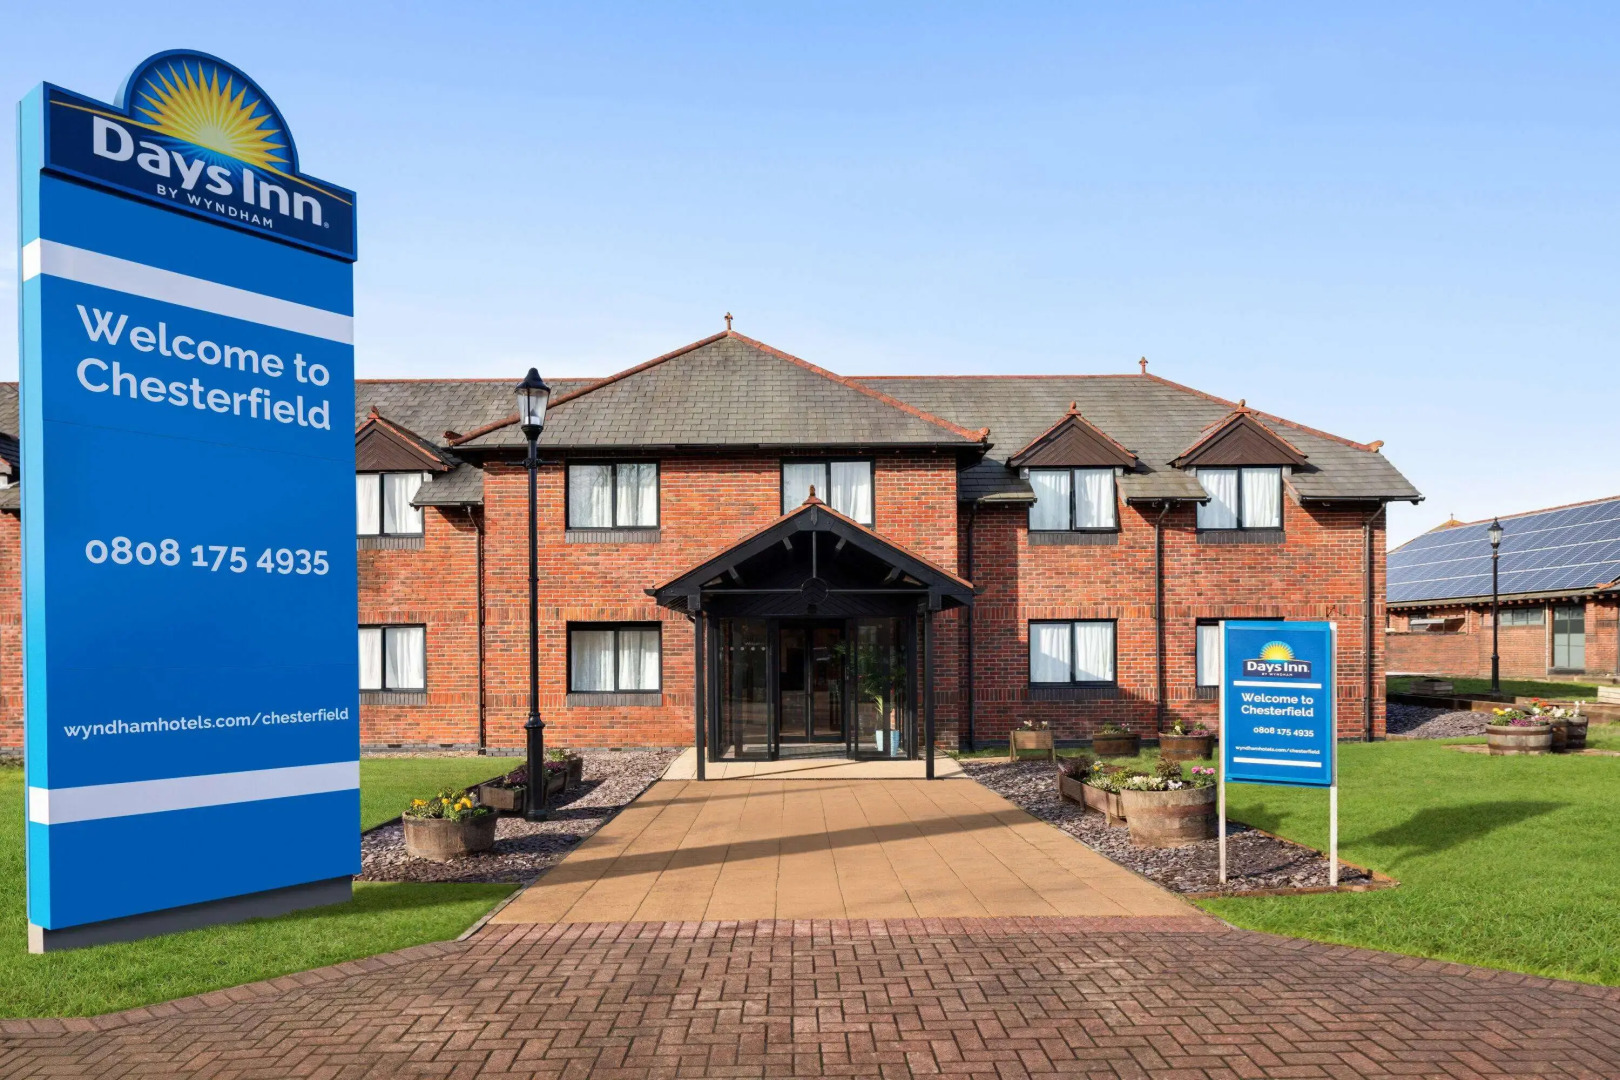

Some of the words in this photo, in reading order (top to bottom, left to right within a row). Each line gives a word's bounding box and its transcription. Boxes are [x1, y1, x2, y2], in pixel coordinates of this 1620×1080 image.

[94, 115, 233, 195] Days
[242, 168, 321, 225] Inn
[156, 183, 178, 198] BY
[187, 193, 273, 228] WYNDHAM
[76, 304, 285, 377] Welcome
[293, 353, 330, 387] to
[77, 358, 330, 431] Chesterfield
[85, 536, 181, 567] 0808
[190, 545, 248, 573] 175
[256, 548, 330, 575] 4935
[1247, 661, 1281, 672] Days
[1284, 662, 1306, 672] Inn
[1241, 692, 1298, 704] Welcome
[1301, 695, 1314, 704] to
[1241, 705, 1314, 717] Chesterfield
[64, 708, 349, 740] wyndhamhotels.com/chesterfield
[1253, 726, 1275, 734] 0808
[1277, 728, 1292, 736] 175
[1293, 729, 1314, 737] 4935
